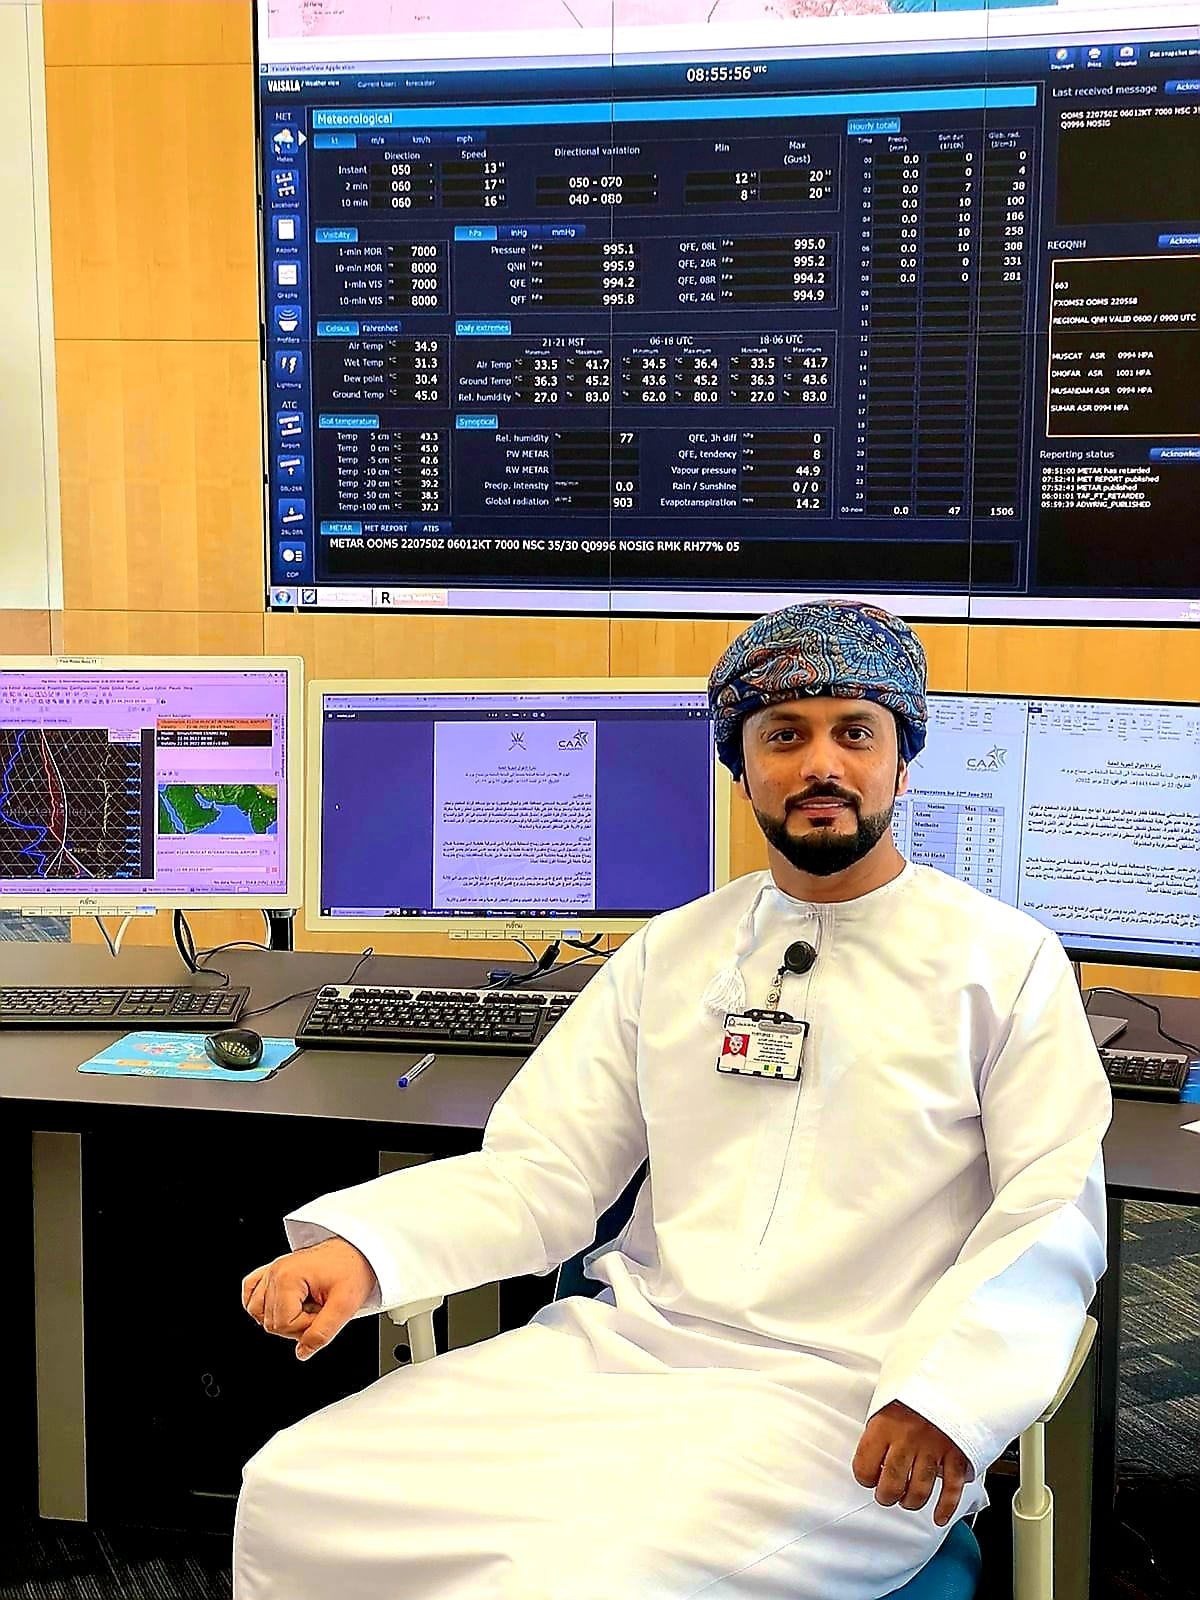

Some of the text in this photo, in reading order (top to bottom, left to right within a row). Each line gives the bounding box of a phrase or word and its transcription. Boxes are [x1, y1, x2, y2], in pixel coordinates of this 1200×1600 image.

[686, 65, 767, 82] 08:55:56 UTC
[268, 80, 300, 93] VAISALA
[1053, 85, 1157, 97] Last received message
[275, 112, 291, 121] MET
[1154, 108, 1172, 116] 7000
[317, 113, 392, 125] Meteorological
[850, 120, 897, 132] Hourly totals
[714, 144, 730, 152] Min
[789, 141, 806, 150] Max
[385, 151, 420, 160] Direction
[461, 150, 486, 159] Speed
[554, 146, 640, 157] Directional variation
[784, 154, 810, 165] (Gust)
[339, 162, 497, 175] Instant 050 13
[569, 176, 622, 188] 050 070
[735, 172, 748, 184] 12
[809, 171, 822, 182] 20
[392, 179, 497, 192] 060 17
[491, 243, 634, 255] Pressure 995.1
[679, 239, 825, 252] QFE, 08L 995.0
[1048, 240, 1086, 250] REGQNH
[339, 246, 436, 257] 1-min MOR 7000
[335, 262, 436, 273] 10-min MOR 8000
[507, 260, 634, 272] QNH 995.9
[679, 256, 825, 269] QFE, 26R 995.2
[509, 277, 634, 288] QFE 994.2
[340, 295, 437, 306] 10-min VIS 8000
[1053, 316, 1089, 324] REGIONAL
[1160, 314, 1178, 322] 0900
[363, 324, 398, 332] Fahrenheit
[474, 323, 508, 332] extremes
[542, 337, 586, 347] 21-21 MST
[650, 336, 694, 346] 06-18 UTC
[760, 334, 803, 344] 18-06 UTC
[349, 341, 437, 352] Air Temp 34.9
[1052, 352, 1082, 360] MUSCAT
[534, 358, 718, 371] 33.5 41.7 34.5 36.4
[1088, 369, 1103, 377] ASR
[344, 374, 437, 385] Dew point 30.4
[534, 374, 718, 387] 36.3 45.2 43.6 45.2
[333, 390, 437, 401] Ground Temp 45.0
[476, 391, 718, 403] humidity 27.0 83.0 62.0 80.0
[514, 433, 633, 444] humidity 77
[700, 449, 737, 460] tendency
[1040, 450, 1114, 459] Reporting status
[671, 465, 820, 477] Vapour pressure 44.9
[485, 481, 633, 492] Precip. intensity 0.0
[700, 481, 737, 492] Sunshine
[485, 497, 633, 508] Global radiation 903
[660, 498, 820, 509] Evapotranspiration 14.2
[990, 507, 1014, 516] 1506
[330, 538, 740, 553] METAR OOMS 220750Z 06012KT 7000 NSC 35/30 Q0996 NOSIG RMK RH77% 05
[381, 592, 390, 603] R
[558, 740, 582, 748] CAA
[966, 758, 998, 769] CAA
